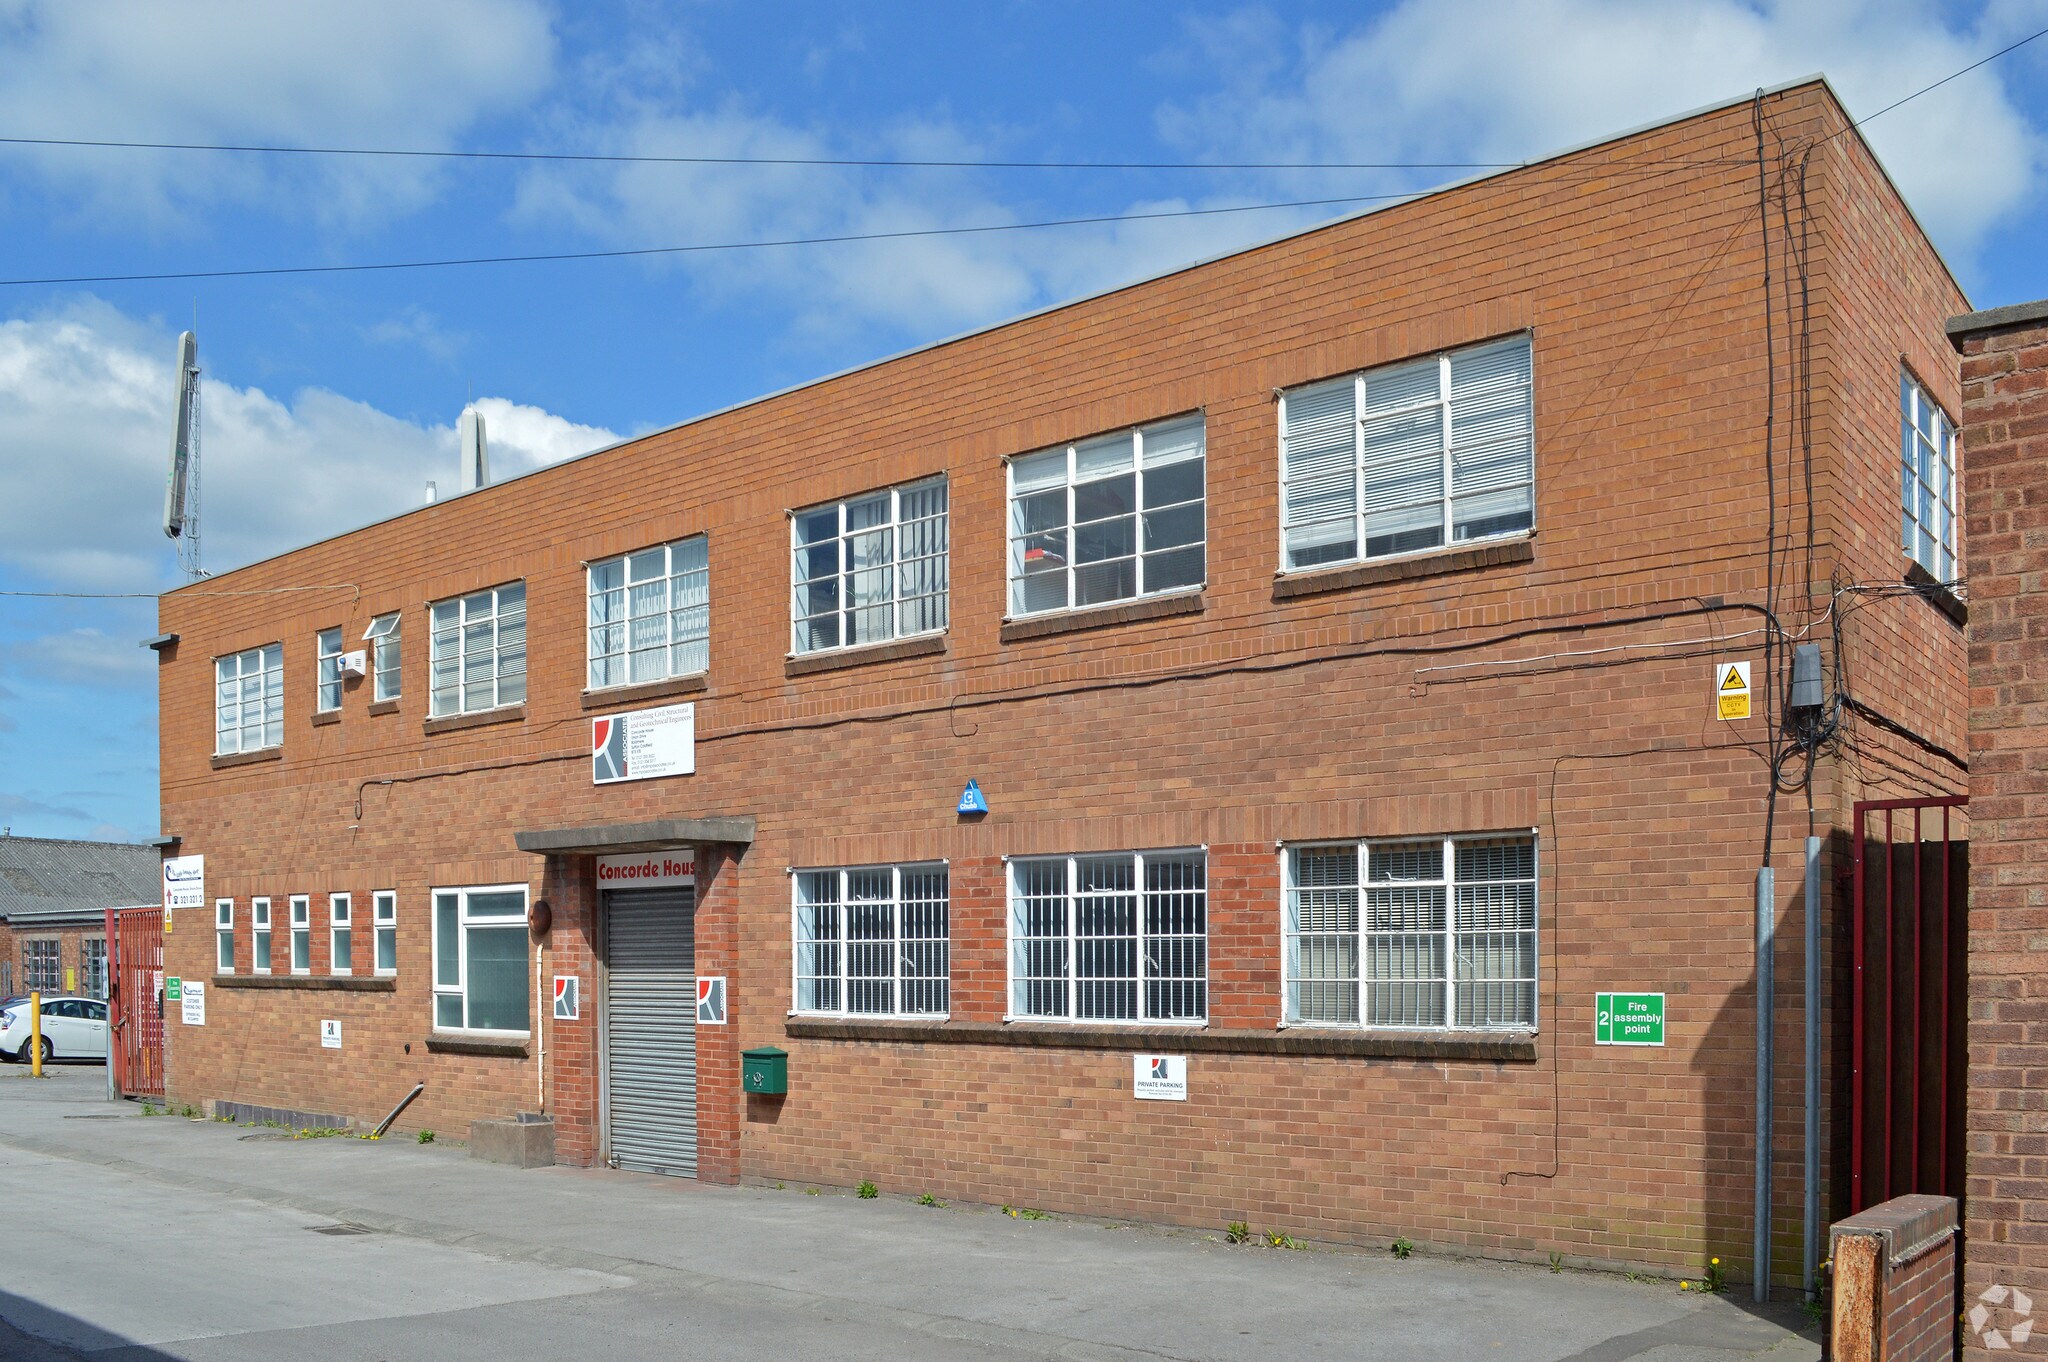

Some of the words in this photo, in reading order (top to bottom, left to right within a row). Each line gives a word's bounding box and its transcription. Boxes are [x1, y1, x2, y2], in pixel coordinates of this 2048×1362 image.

[630, 712, 654, 721] Consulting
[666, 706, 689, 715] Structural
[640, 717, 669, 727] Geotechnical
[669, 715, 692, 723] Engineers
[599, 860, 659, 880] Concorde
[663, 860, 695, 876] Hous
[180, 895, 188, 904] 321
[190, 895, 198, 903] 321
[199, 894, 203, 903] 2
[1628, 1002, 1647, 1011] Fire
[1599, 1011, 1609, 1025] 2
[1614, 1014, 1661, 1024] assembly
[1625, 1025, 1650, 1034] point
